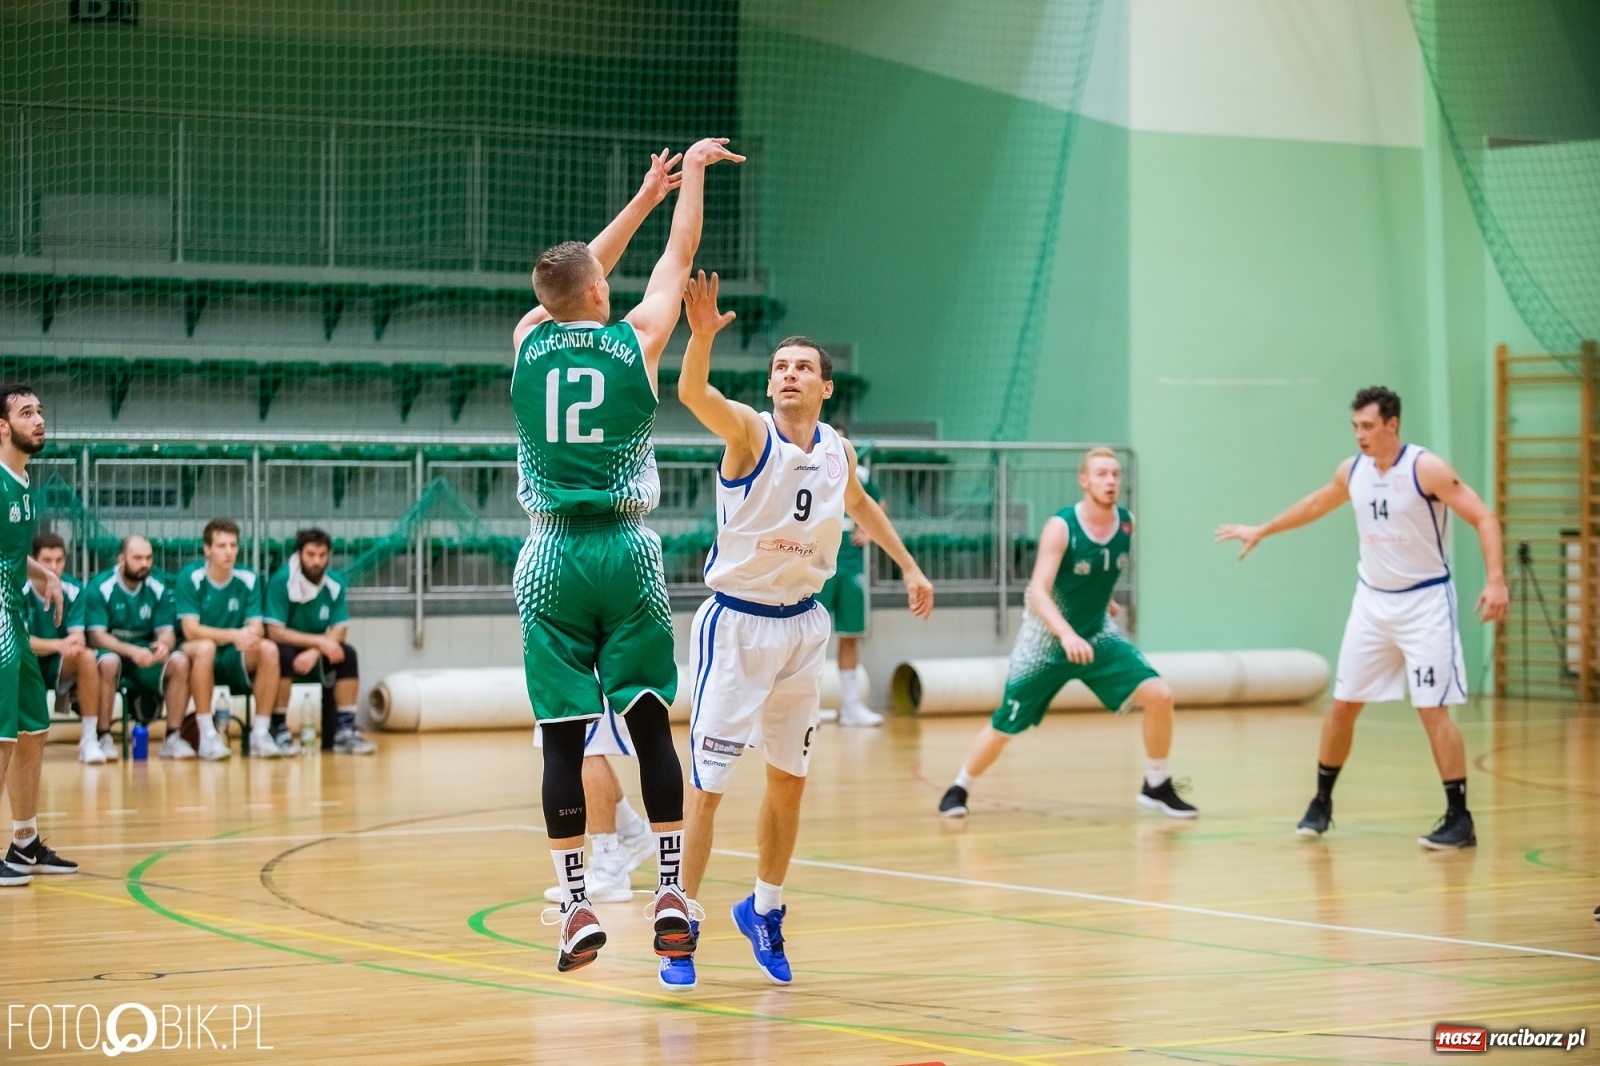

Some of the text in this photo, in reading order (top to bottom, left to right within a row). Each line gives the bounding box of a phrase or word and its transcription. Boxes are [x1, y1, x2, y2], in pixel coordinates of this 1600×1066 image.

[525, 331, 636, 367] POLITECHNIKA ŚLĄSKA
[546, 367, 605, 443] 12
[22, 493, 31, 521] 9
[794, 488, 812, 521] 9
[1369, 499, 1389, 520] 14
[1413, 667, 1436, 687] 14
[1007, 699, 1020, 722] 7
[558, 806, 584, 817] SIWY
